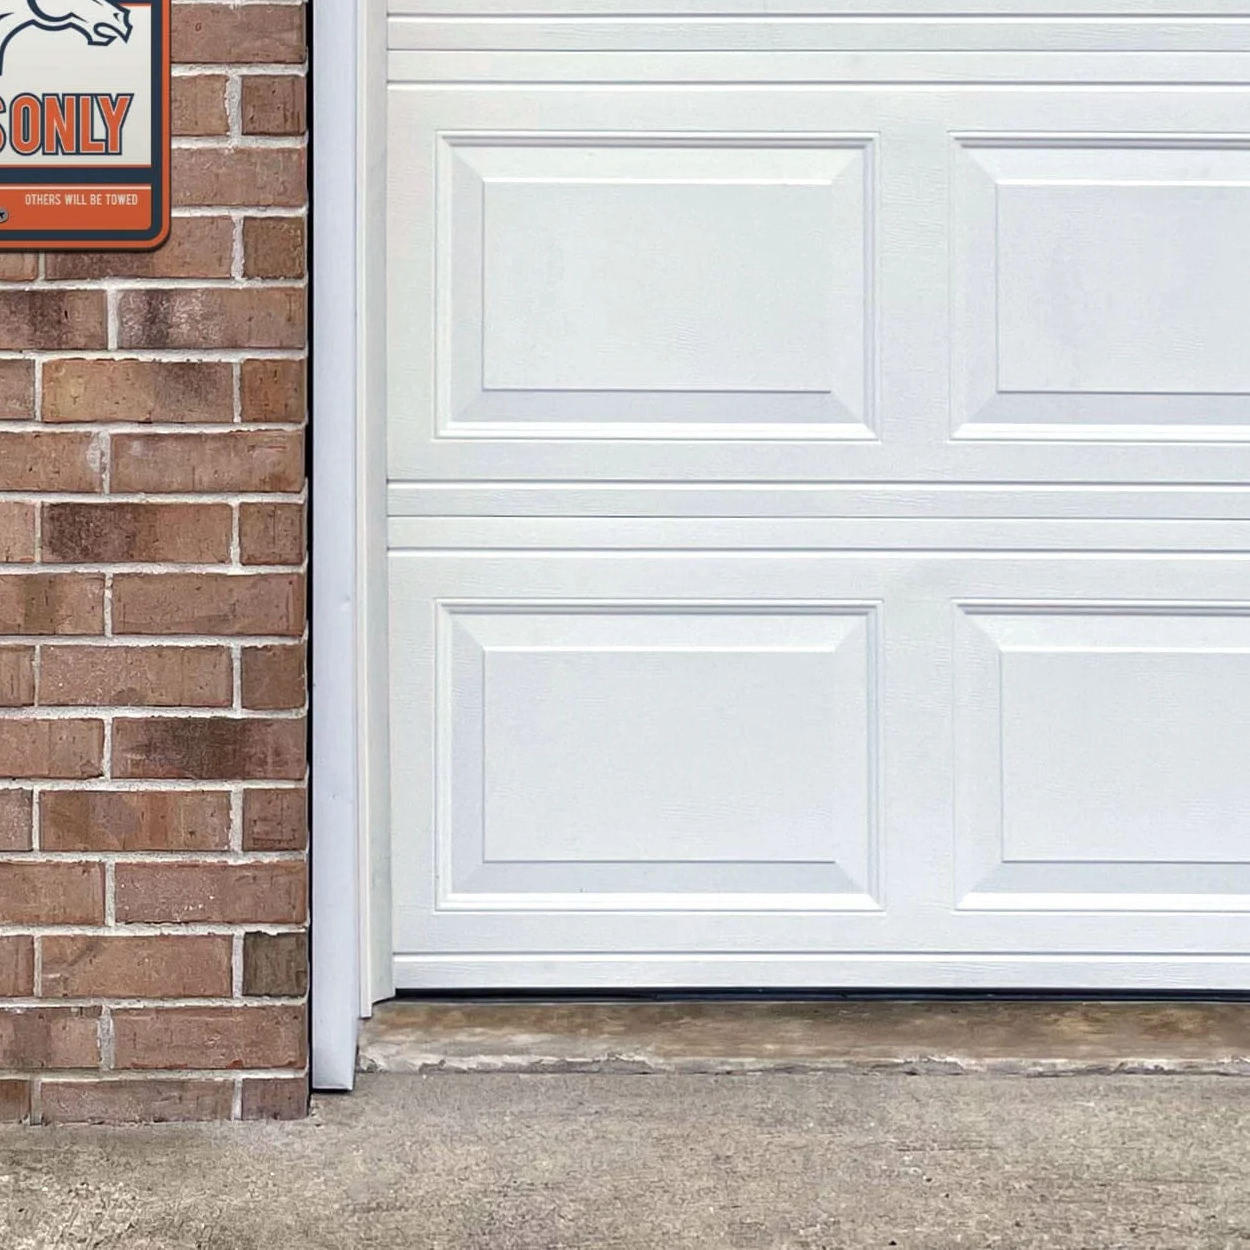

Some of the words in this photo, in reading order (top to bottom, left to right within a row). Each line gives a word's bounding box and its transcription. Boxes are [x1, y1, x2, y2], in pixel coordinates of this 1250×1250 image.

[10, 92, 134, 156] ONLY
[24, 193, 61, 206] OTHERS
[64, 193, 87, 206] WILL
[90, 193, 103, 206] BE
[105, 193, 138, 206] TOWED
